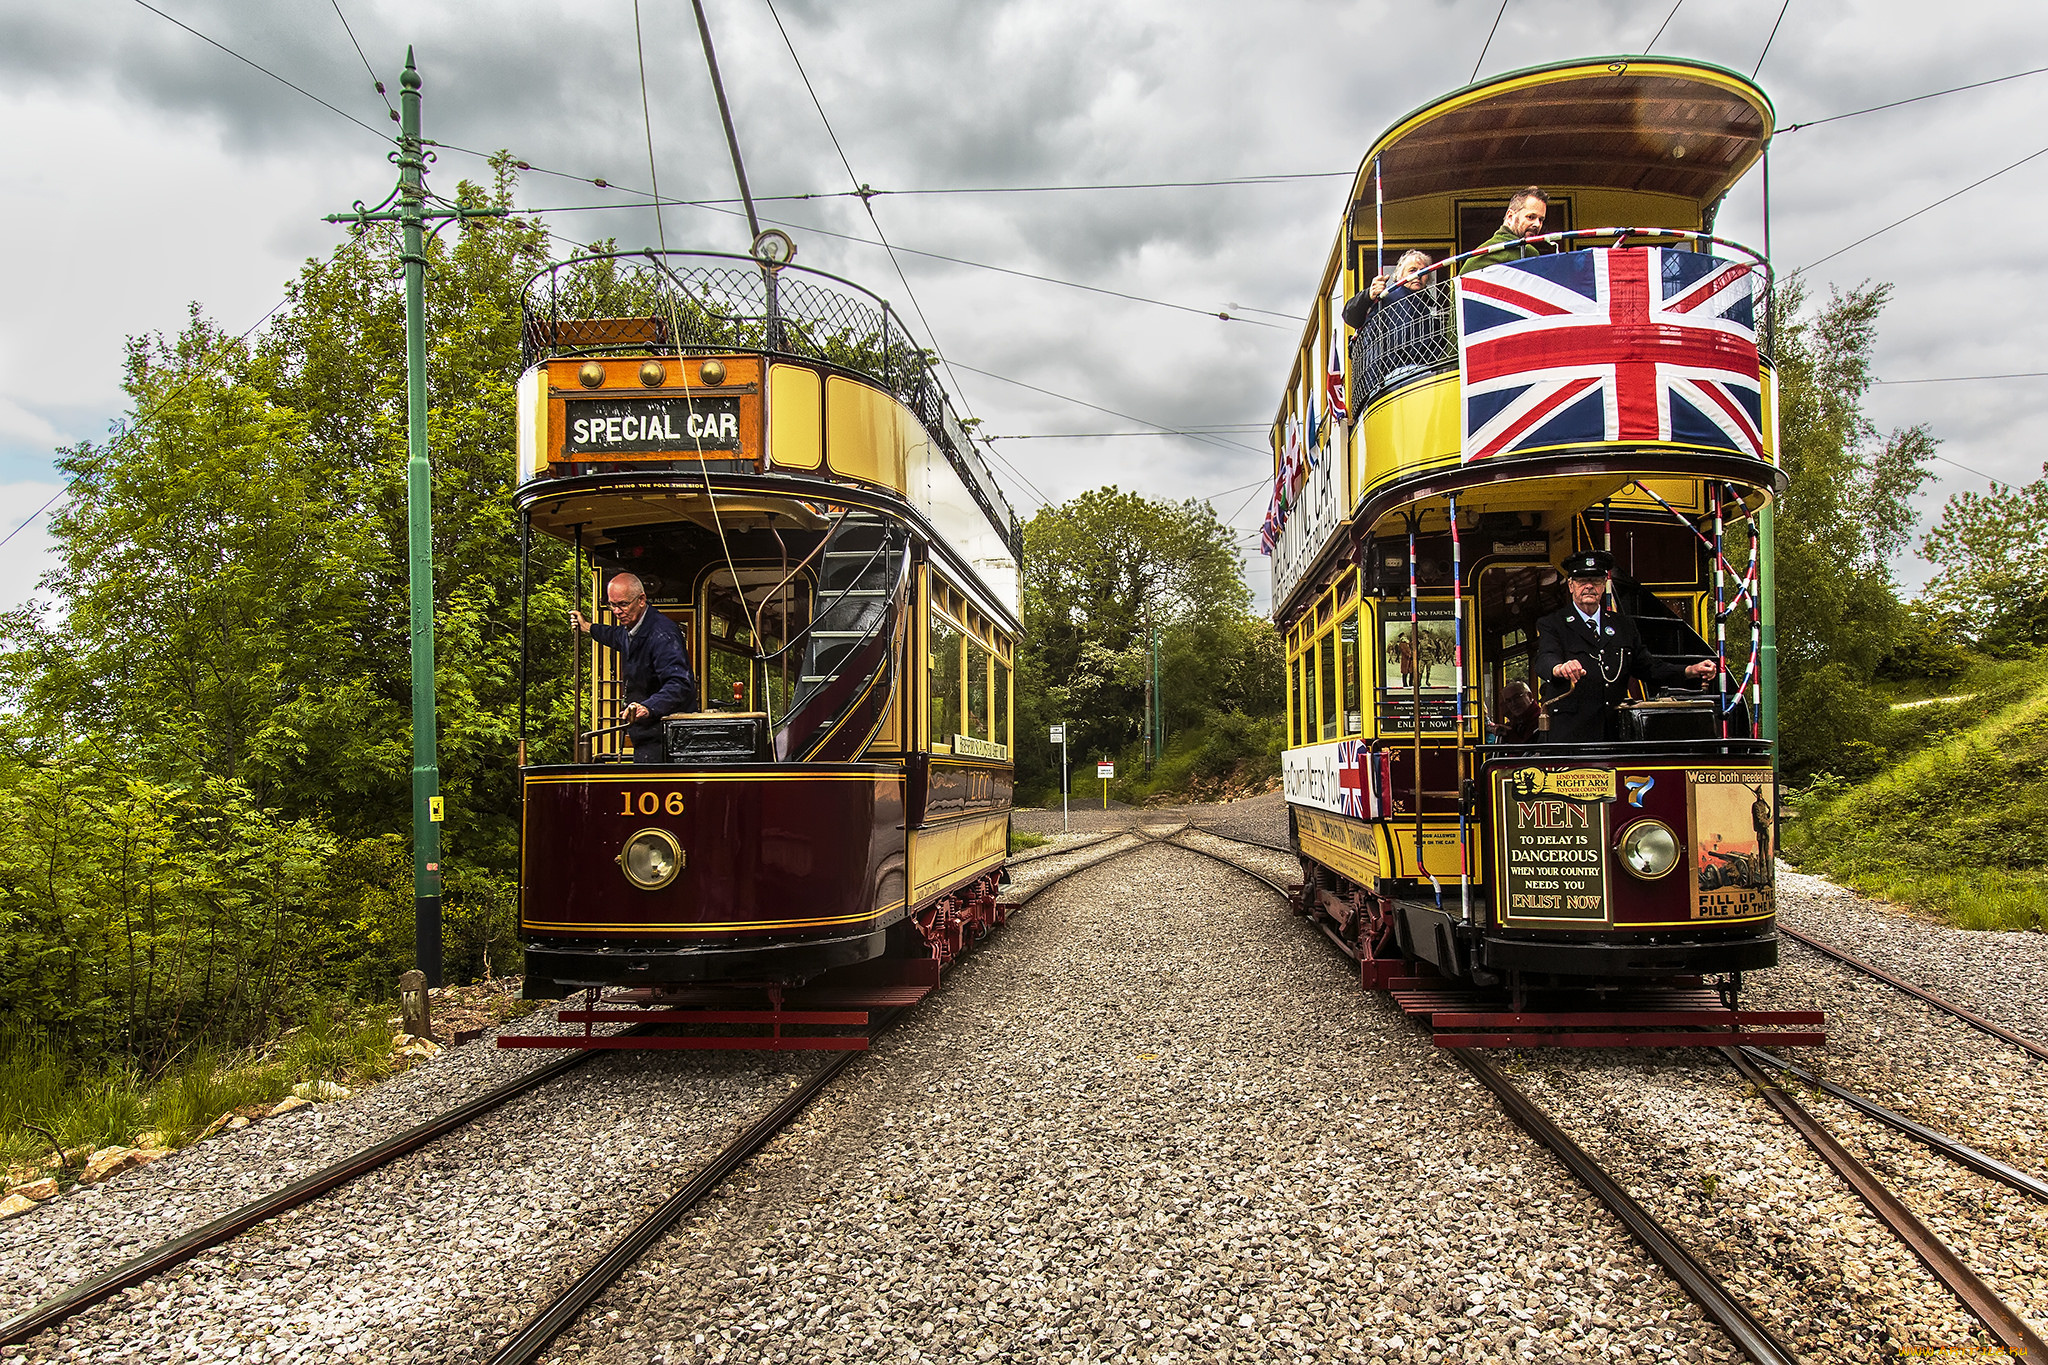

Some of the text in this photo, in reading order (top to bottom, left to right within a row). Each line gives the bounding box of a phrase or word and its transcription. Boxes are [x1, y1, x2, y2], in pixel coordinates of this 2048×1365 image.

[573, 412, 739, 444] SPECIAL CAR
[1314, 437, 1333, 521] CAR
[1719, 771, 1740, 783] both
[1742, 772, 1763, 783] needed
[1624, 775, 1655, 808] 7
[621, 791, 685, 816] 106
[1517, 800, 1590, 829] MEN
[1520, 836, 1588, 845] TO DELAY IS
[1511, 849, 1598, 862] DANGEROUS
[1510, 866, 1600, 876] WHEN YOUR COUNTRY
[1525, 880, 1585, 890] NEEDS YOU
[1512, 894, 1602, 910] ENLIST NOW
[1699, 890, 1774, 905] FILL UP THE
[1699, 905, 1728, 916] PILE
[1734, 904, 1749, 914] UP
[1752, 902, 1767, 913] THE
